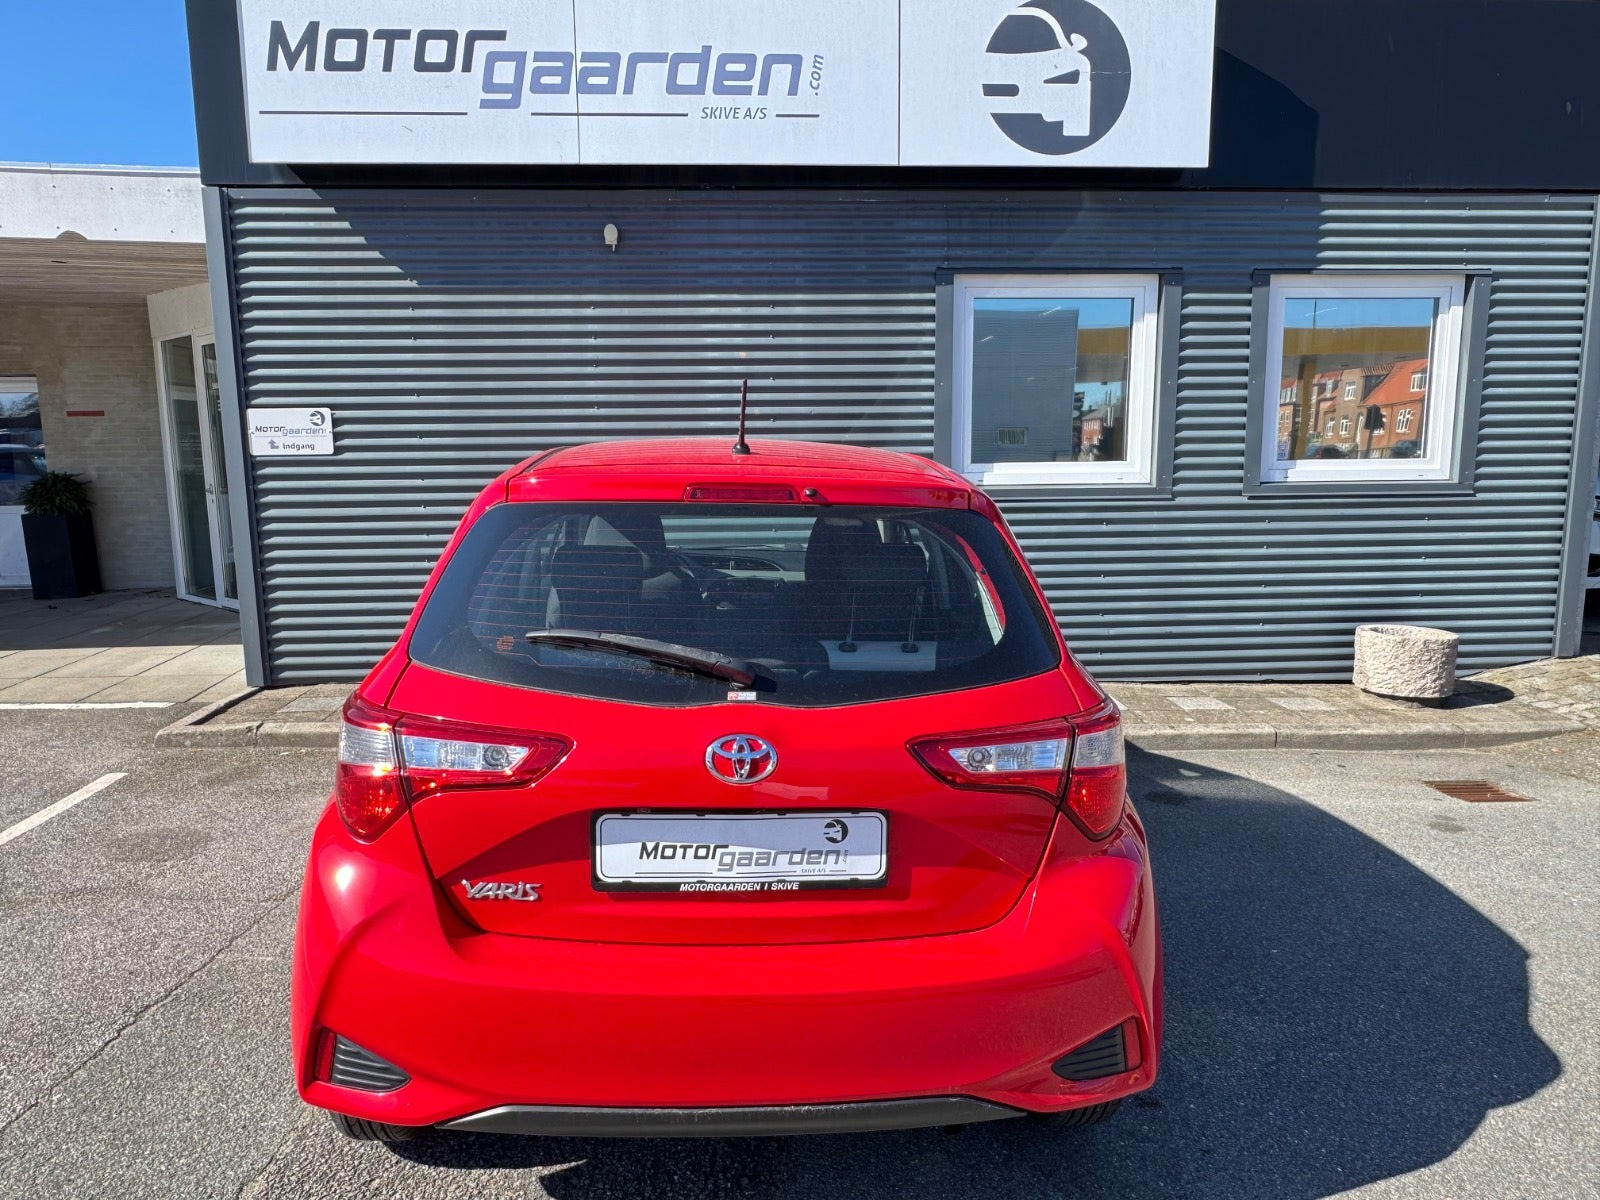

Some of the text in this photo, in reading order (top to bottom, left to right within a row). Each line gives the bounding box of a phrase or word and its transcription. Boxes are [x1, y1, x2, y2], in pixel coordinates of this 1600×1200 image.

[809, 54, 824, 96] .com
[701, 106, 767, 119] SKIVE A/S
[282, 442, 315, 451] Indgang
[461, 879, 542, 901] YARIS
[680, 883, 761, 891] MOTORGAARDEN
[771, 882, 800, 890] SKIVE
